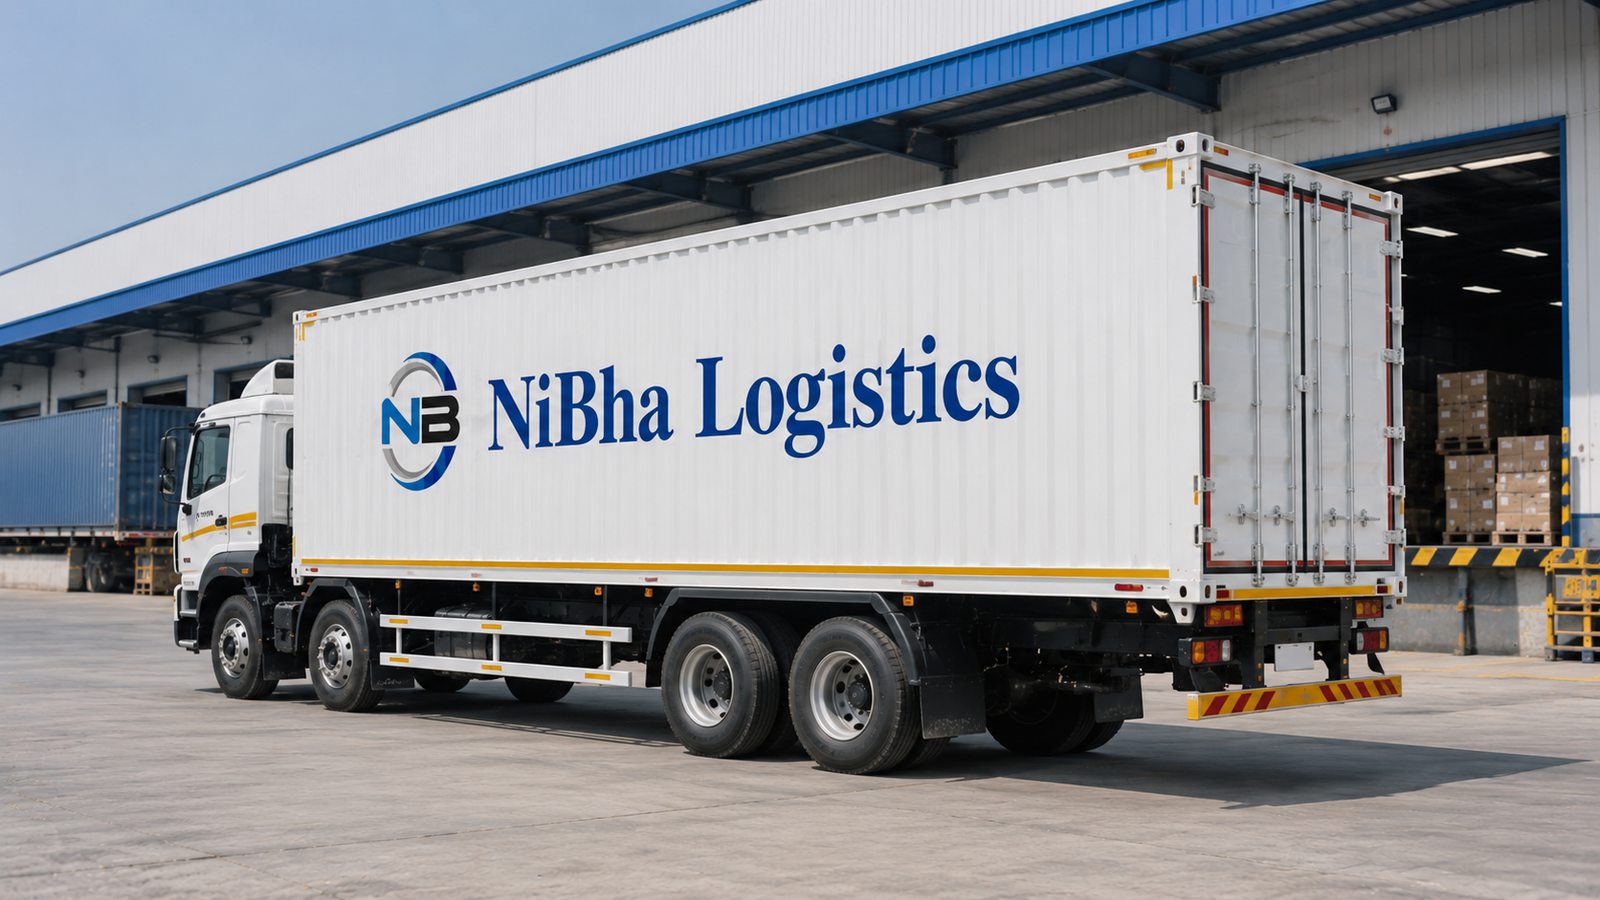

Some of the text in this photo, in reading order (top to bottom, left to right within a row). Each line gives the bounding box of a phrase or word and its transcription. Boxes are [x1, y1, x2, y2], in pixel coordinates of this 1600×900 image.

[381, 395, 461, 445] NB
[488, 335, 1020, 458] NiBha Logistics
